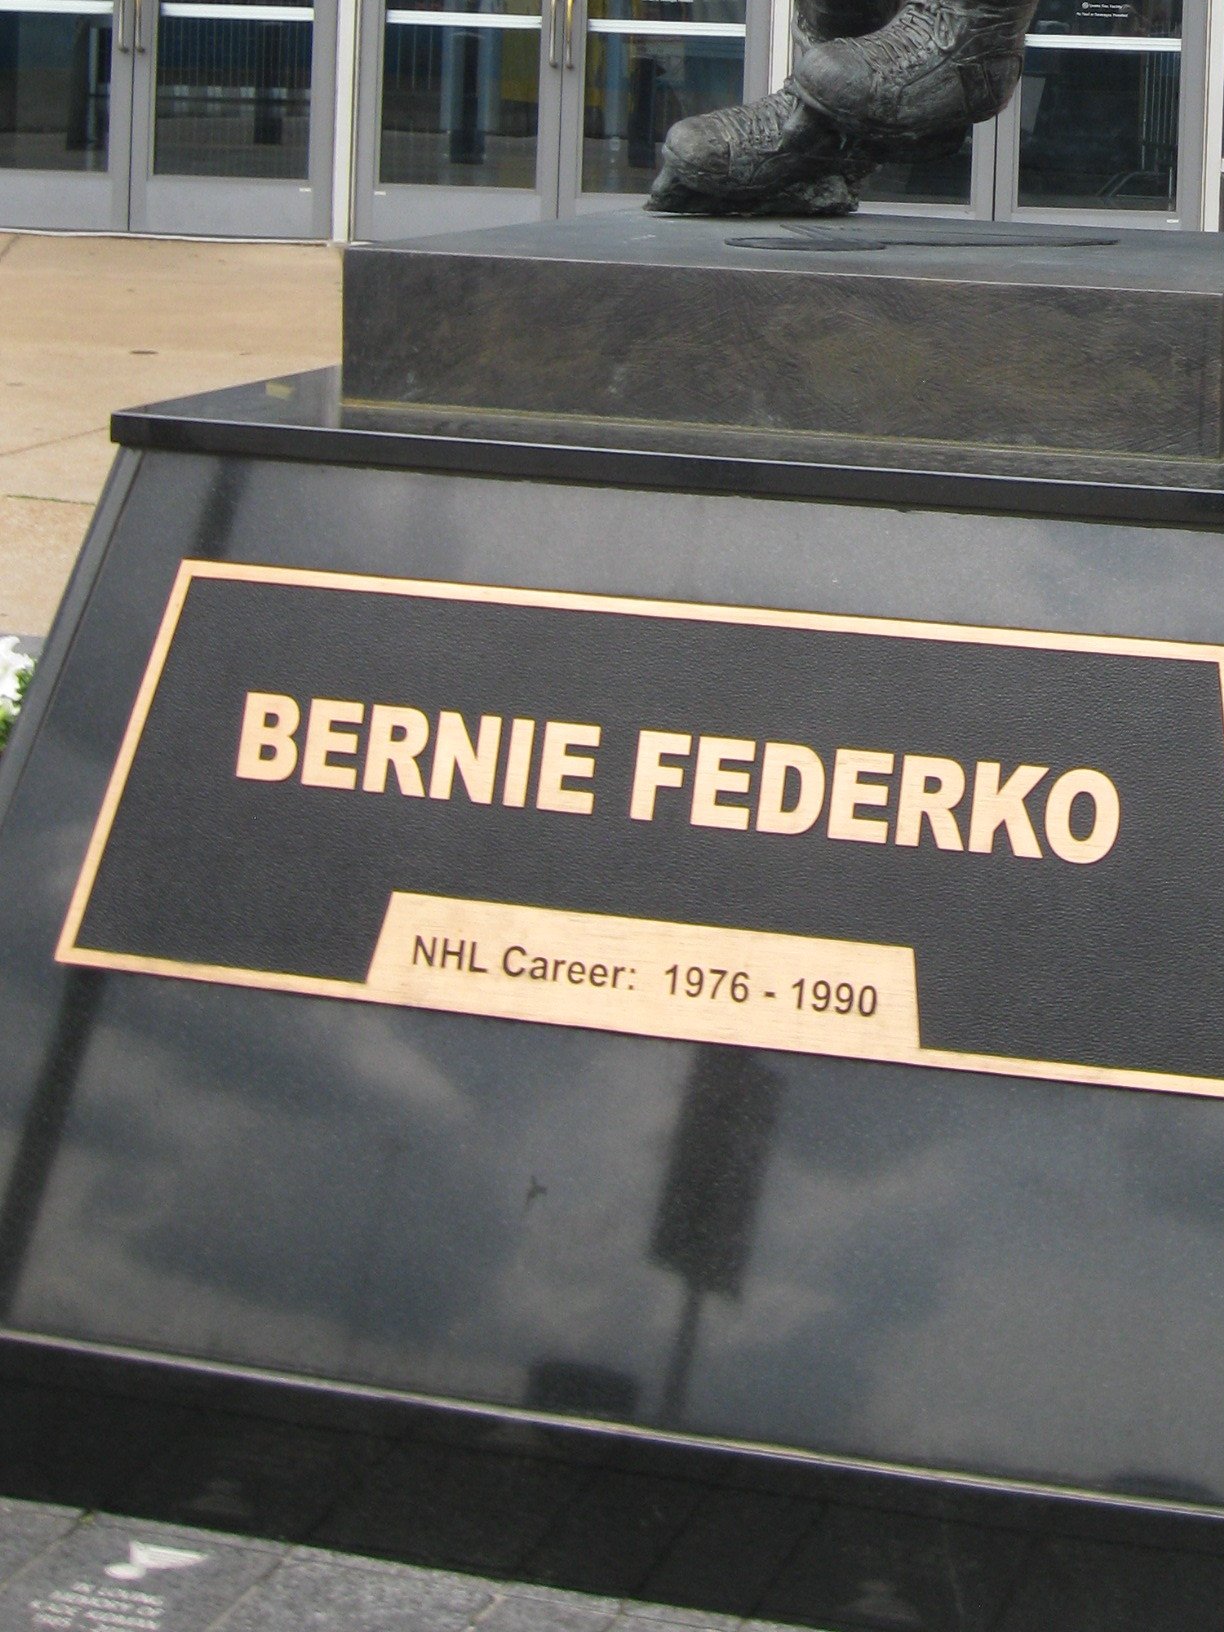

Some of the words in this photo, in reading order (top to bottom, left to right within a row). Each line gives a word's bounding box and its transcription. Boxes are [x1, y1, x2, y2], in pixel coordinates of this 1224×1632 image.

[236, 692, 601, 815] BERNIE
[629, 730, 1121, 864] FEDERKO
[412, 934, 488, 974] NHL
[502, 945, 637, 992] Career:
[663, 964, 749, 1003] 1976
[763, 988, 777, 999] -
[790, 977, 878, 1018] 1990
